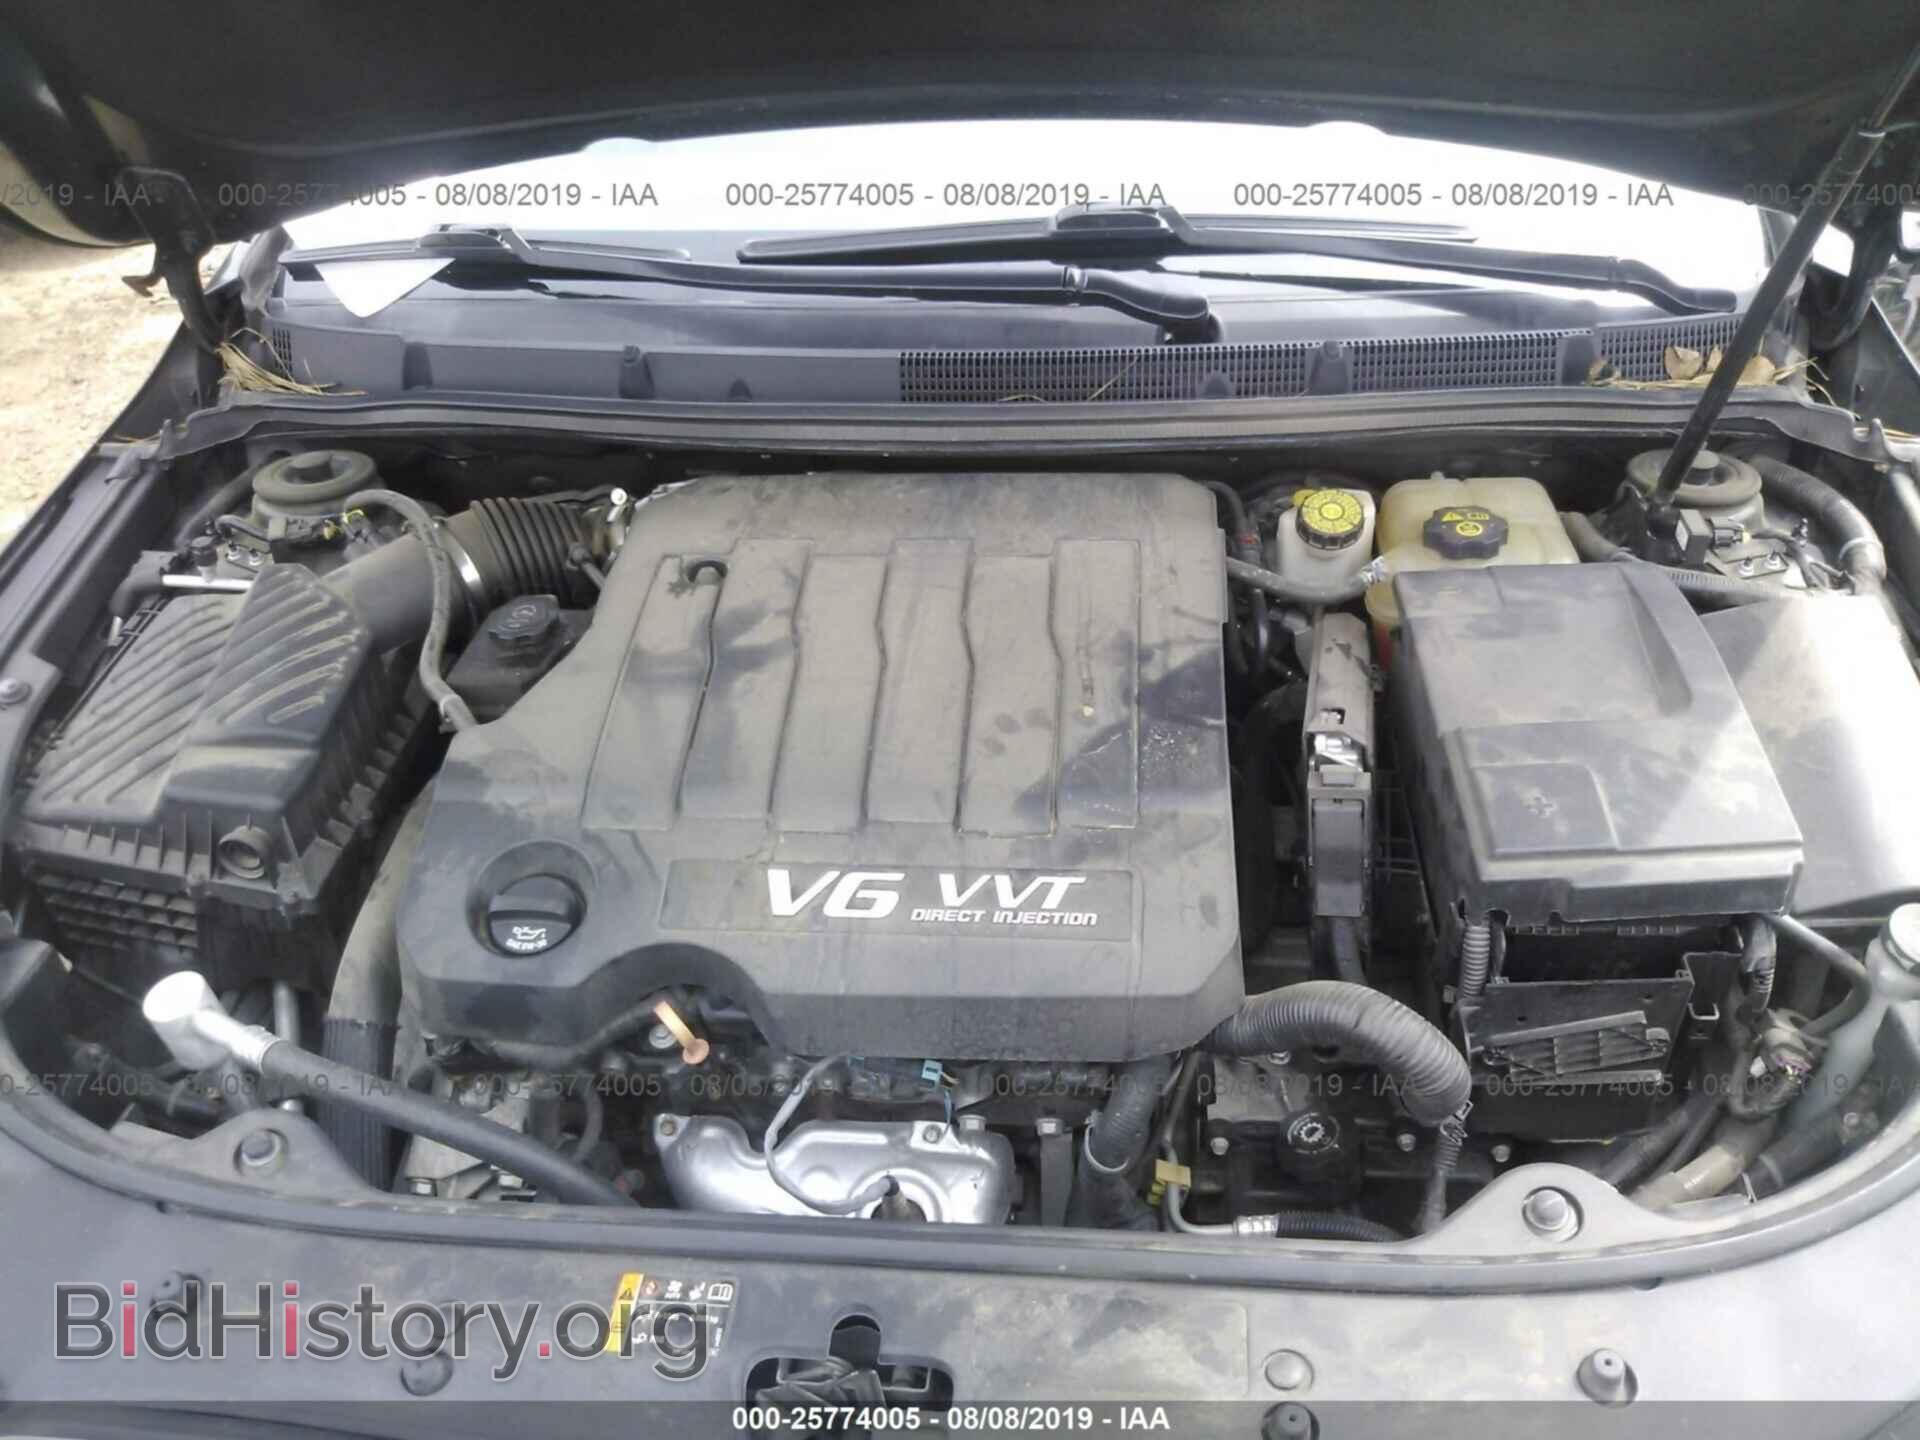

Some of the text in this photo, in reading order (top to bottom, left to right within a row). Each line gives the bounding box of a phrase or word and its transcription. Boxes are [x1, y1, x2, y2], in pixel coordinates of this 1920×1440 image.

[767, 868, 1087, 920] V6 VVT
[910, 907, 1098, 926] DIRECT INJECTION
